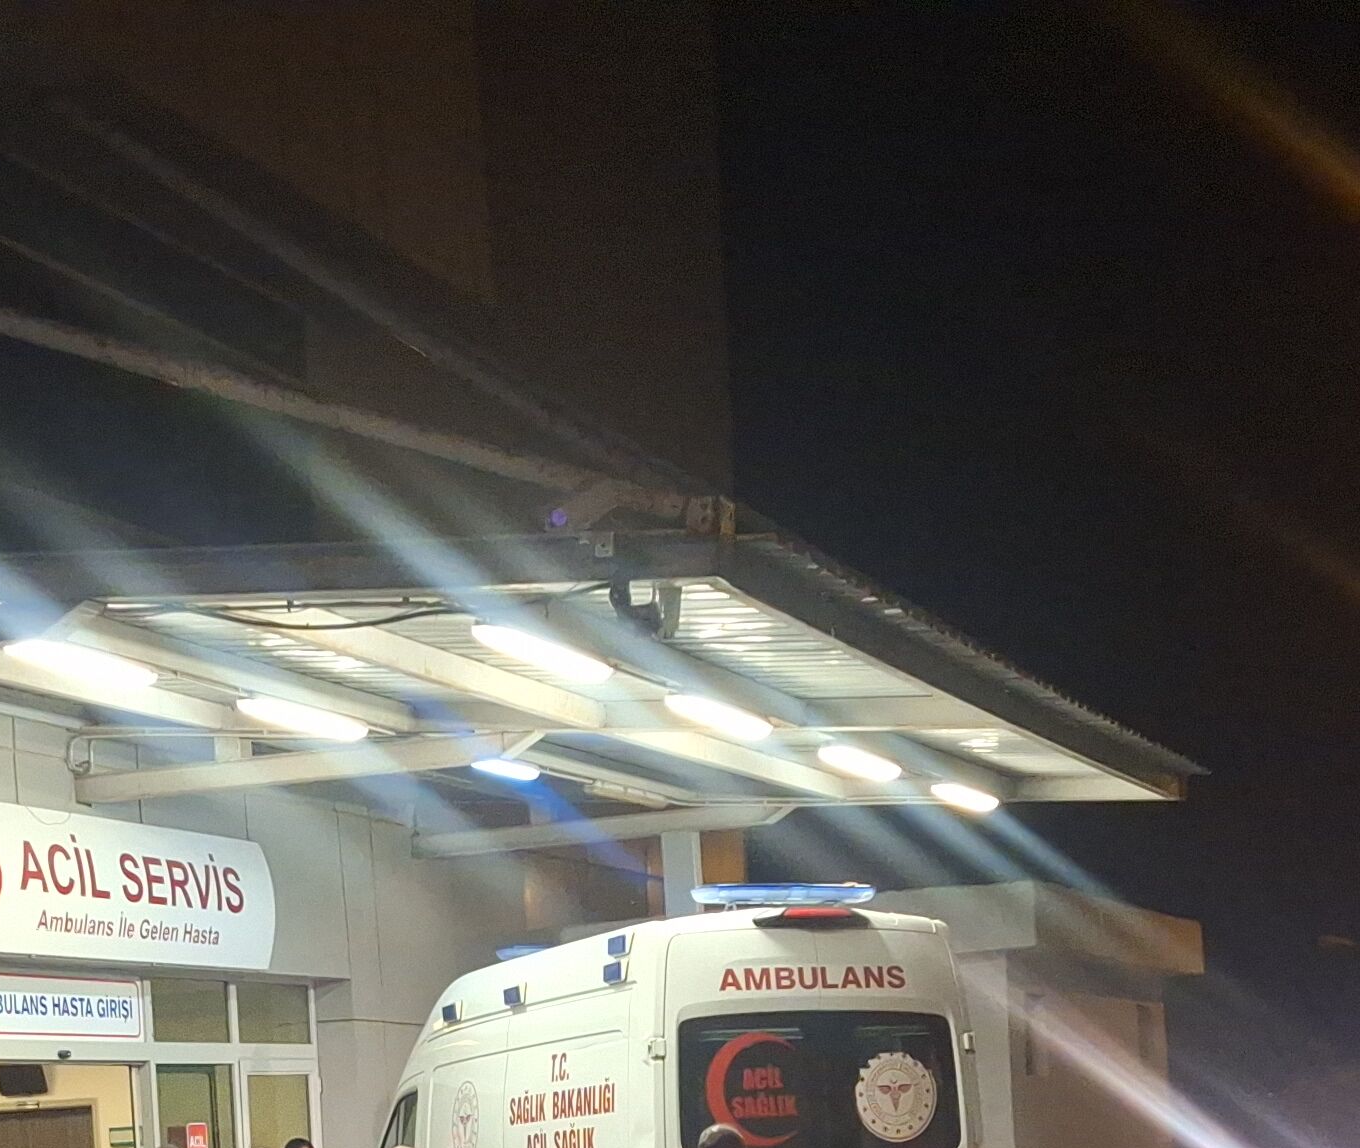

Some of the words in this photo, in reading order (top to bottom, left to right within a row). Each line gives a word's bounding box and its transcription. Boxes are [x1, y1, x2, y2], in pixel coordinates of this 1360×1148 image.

[20, 834, 111, 899] ACİL
[119, 853, 244, 913] SERVİS
[37, 909, 114, 936] Ambulans
[118, 911, 135, 939] İle
[140, 918, 179, 942] Gelen
[183, 923, 220, 945] Hasta
[719, 965, 906, 991] AMBULANS
[52, 996, 94, 1017] HASTA
[96, 995, 133, 1024] GİRİŞİ
[551, 1053, 569, 1082] T.C.
[510, 1090, 546, 1126] SAĞLIK
[552, 1077, 616, 1120] BAKANLIĞI
